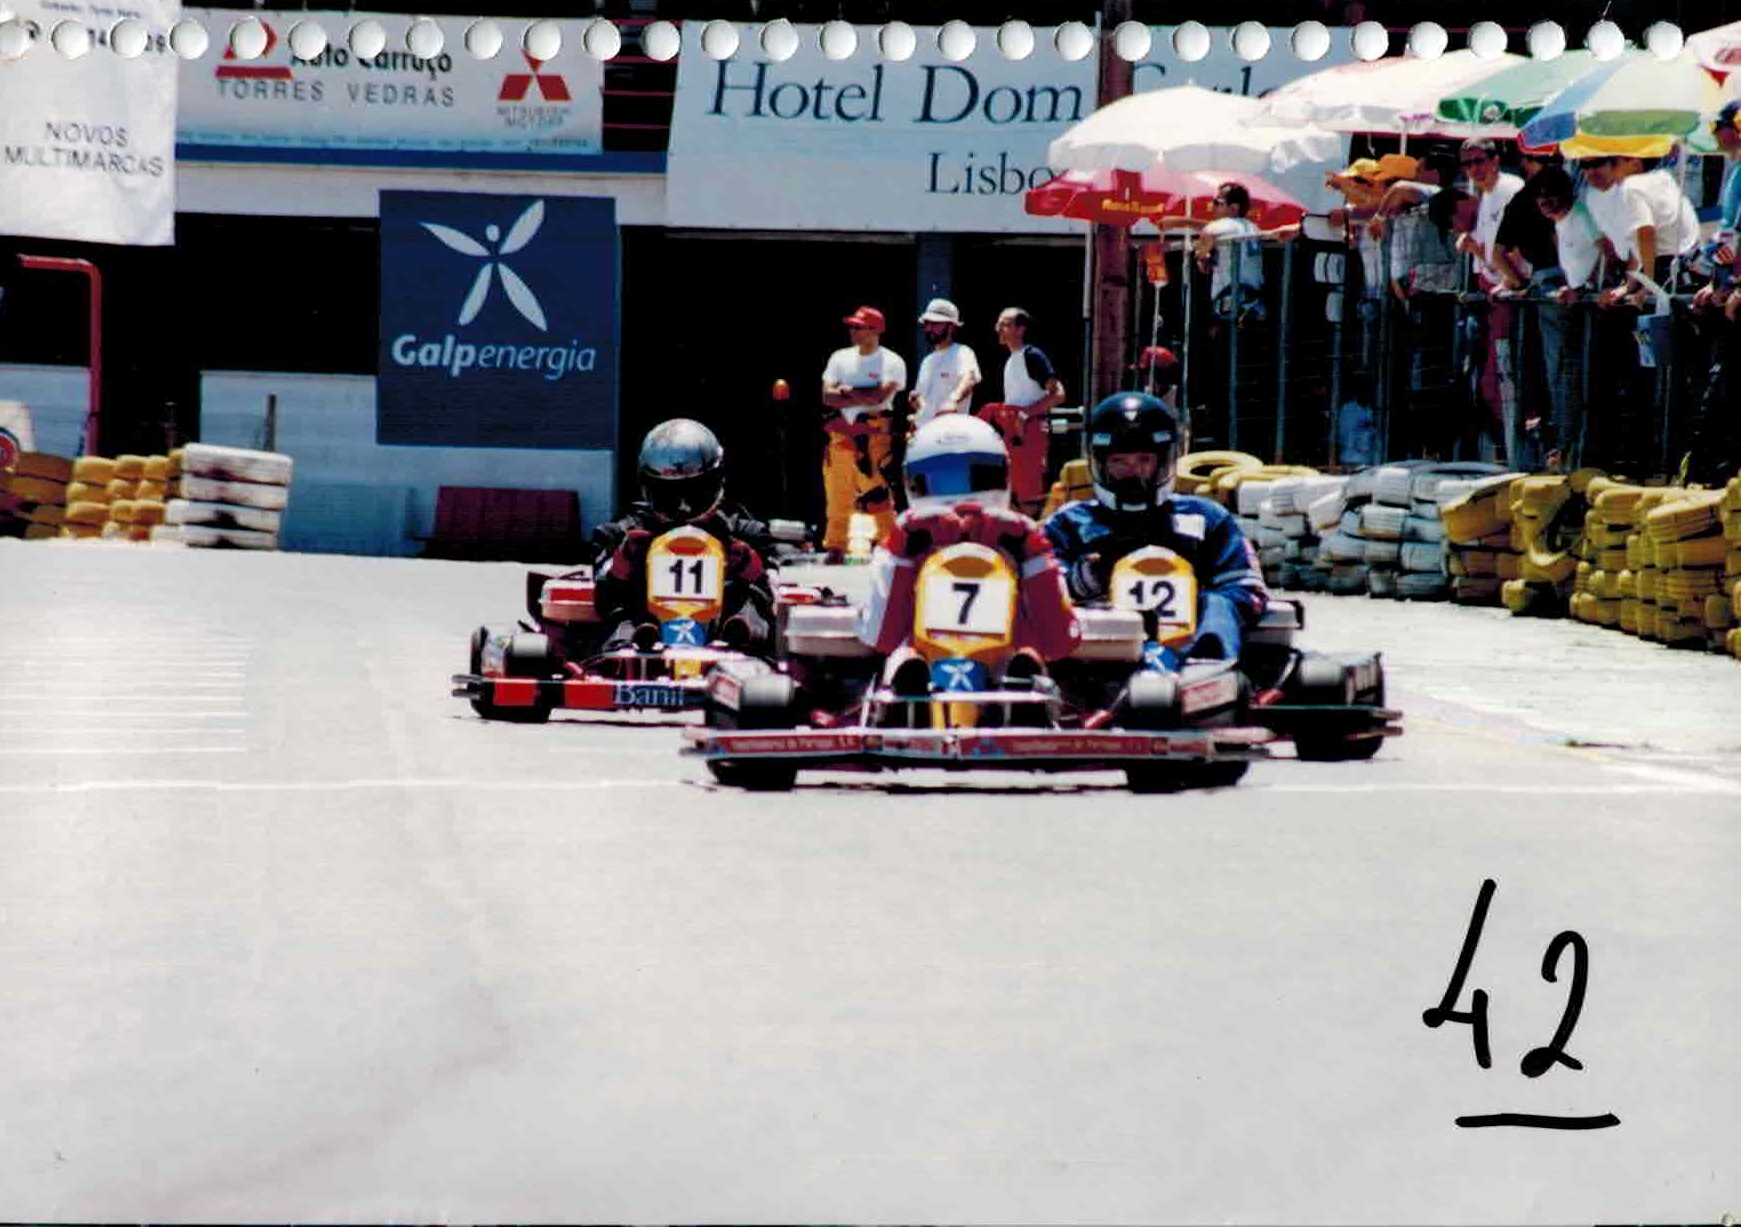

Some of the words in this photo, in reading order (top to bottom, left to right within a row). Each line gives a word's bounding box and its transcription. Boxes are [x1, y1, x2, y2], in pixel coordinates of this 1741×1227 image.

[215, 79, 325, 101] TORRES
[347, 81, 455, 108] VEDRAS
[703, 59, 885, 121] Hotel
[912, 65, 1083, 124] Dom
[46, 121, 129, 148] NOVOS
[4, 144, 165, 177] MULTIMARCAS
[392, 334, 597, 380] Galpenergia
[668, 558, 705, 594] 11
[952, 582, 980, 625] 7
[1128, 580, 1177, 617] 12
[1422, 878, 1589, 1078] 42
